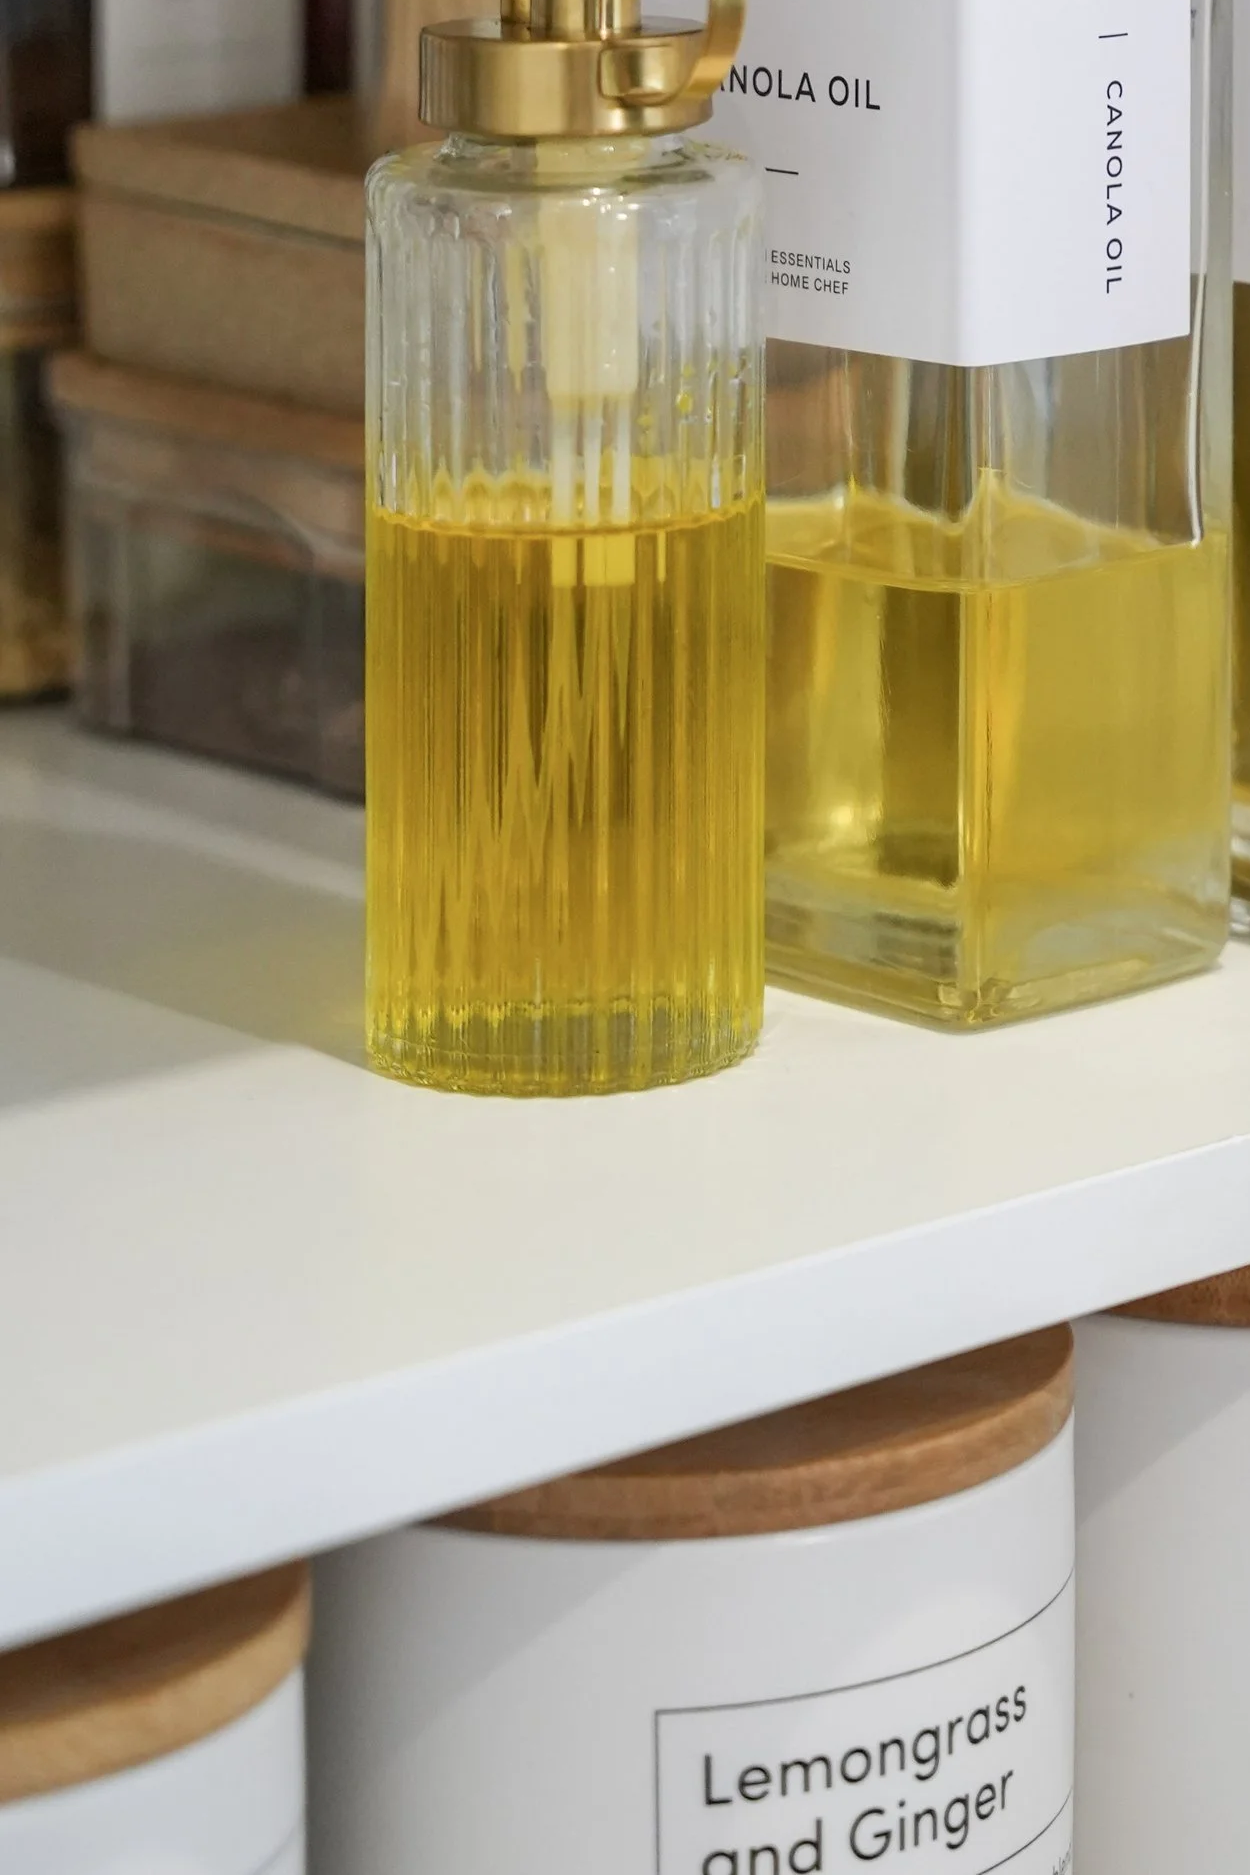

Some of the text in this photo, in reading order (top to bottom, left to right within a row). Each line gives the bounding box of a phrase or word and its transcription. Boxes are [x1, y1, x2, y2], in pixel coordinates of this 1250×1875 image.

[827, 75, 882, 111] OIL
[1105, 79, 1124, 295] CANOLA OIL
[770, 249, 852, 275] ESSENTIALS
[770, 271, 850, 296] HOME CHEF
[703, 1684, 1028, 1807] Lemongrass
[702, 1817, 824, 1875] and
[848, 1769, 1015, 1862] Ginger
